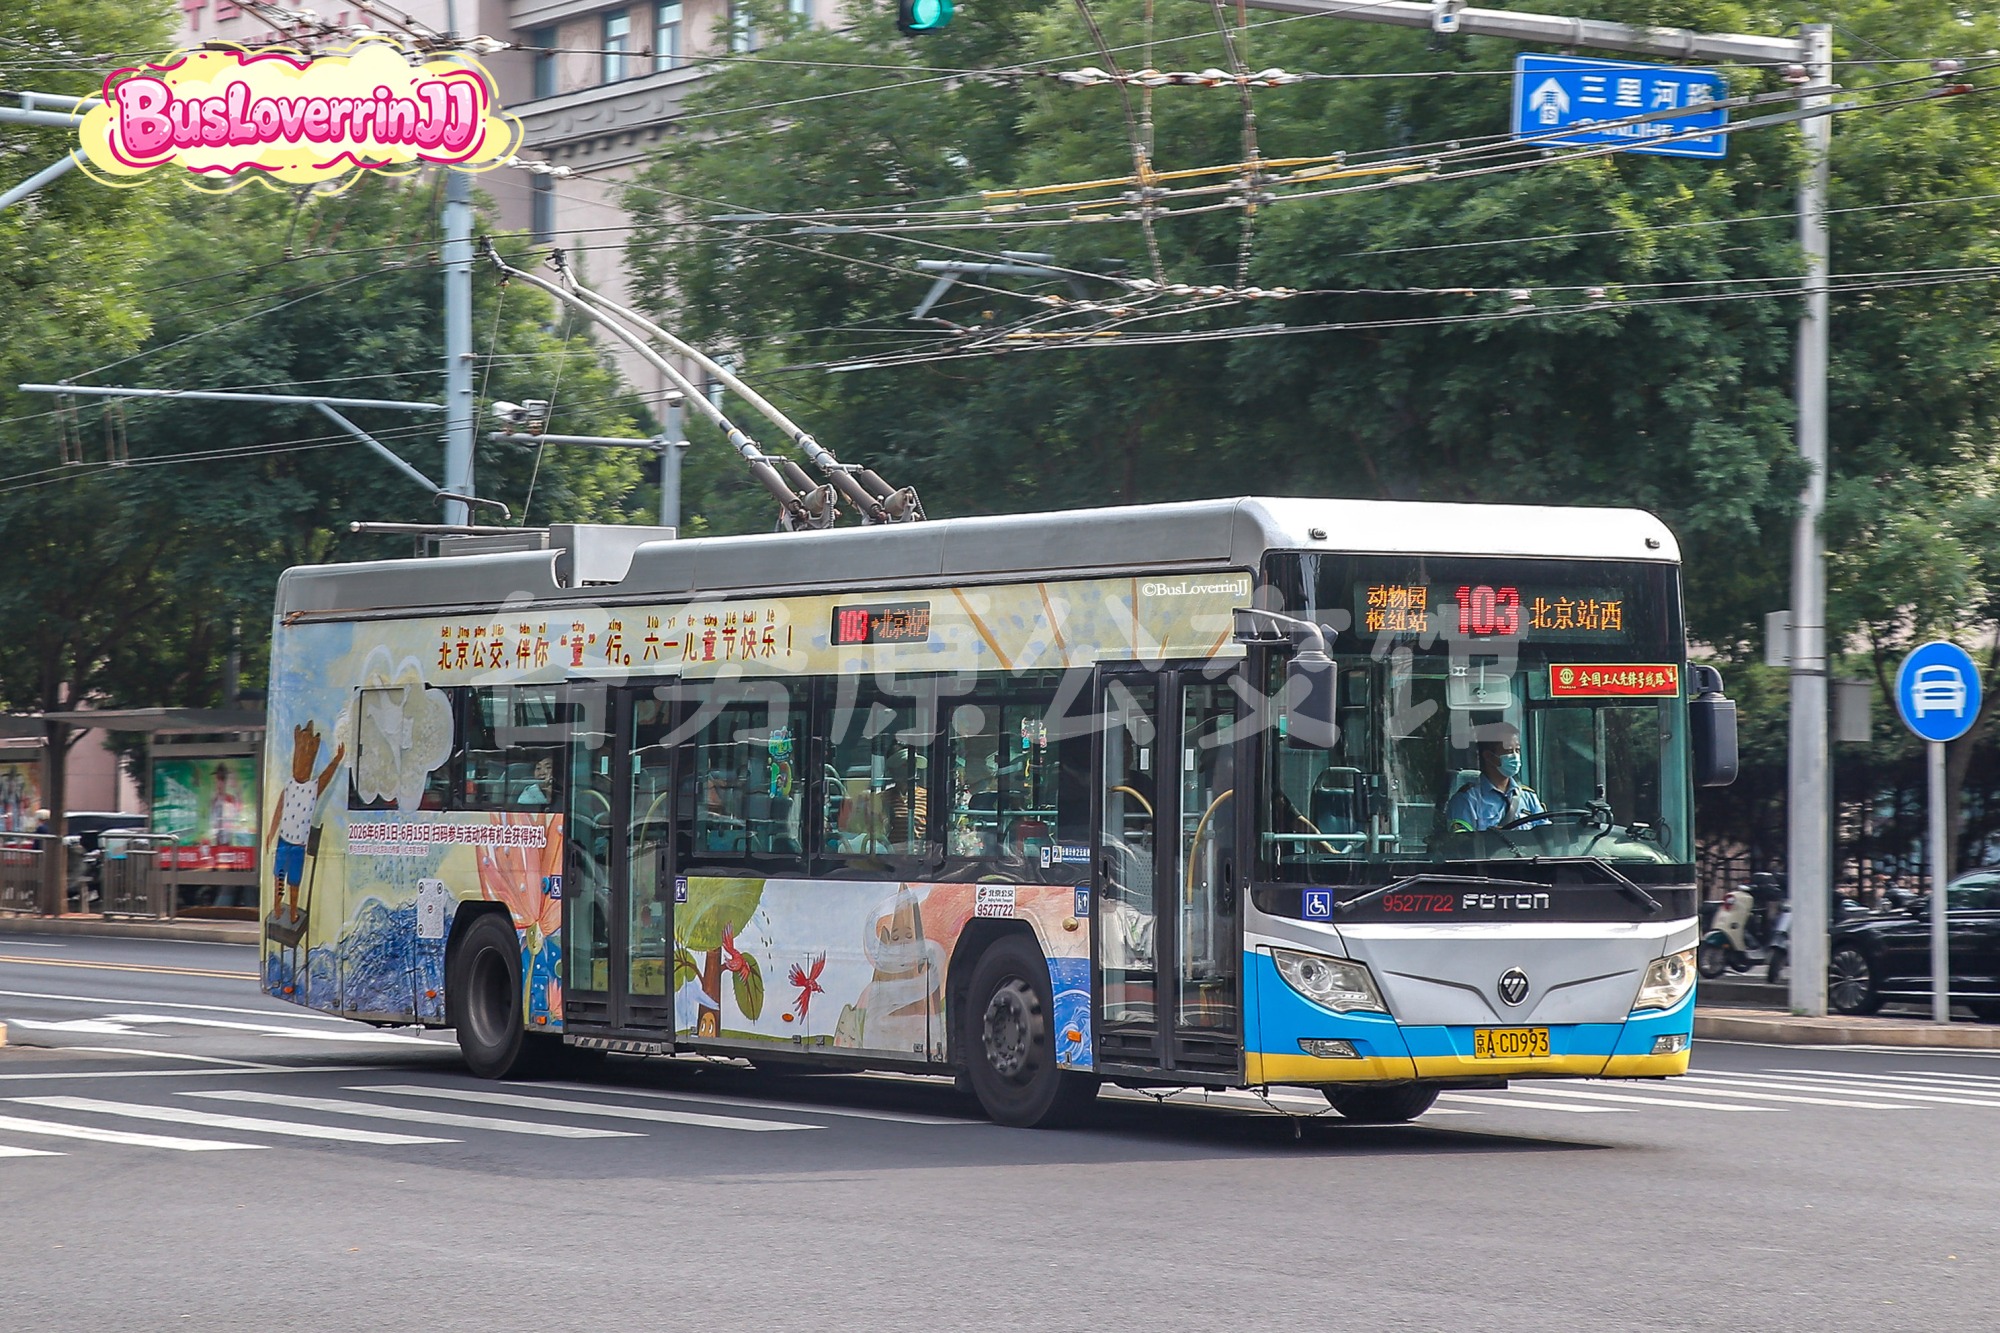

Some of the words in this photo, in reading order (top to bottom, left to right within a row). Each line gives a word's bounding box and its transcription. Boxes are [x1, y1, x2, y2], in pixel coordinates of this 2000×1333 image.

[1578, 75, 1715, 114] 三里河路
[1367, 584, 1428, 610] 动物园
[1366, 609, 1429, 632] 枢纽站
[1456, 585, 1520, 635] 103
[1529, 597, 1623, 631] 北京站西
[839, 610, 869, 642] 103
[879, 607, 930, 639] 北京站西
[1579, 671, 1665, 689] 全国工人先锋号线路
[988, 889, 1013, 898] 北京公交
[1383, 895, 1454, 912] 9527722
[1462, 893, 1550, 910] FOTON
[977, 904, 1013, 916] 9527722
[1476, 1032, 1548, 1053] 京A·CD993
